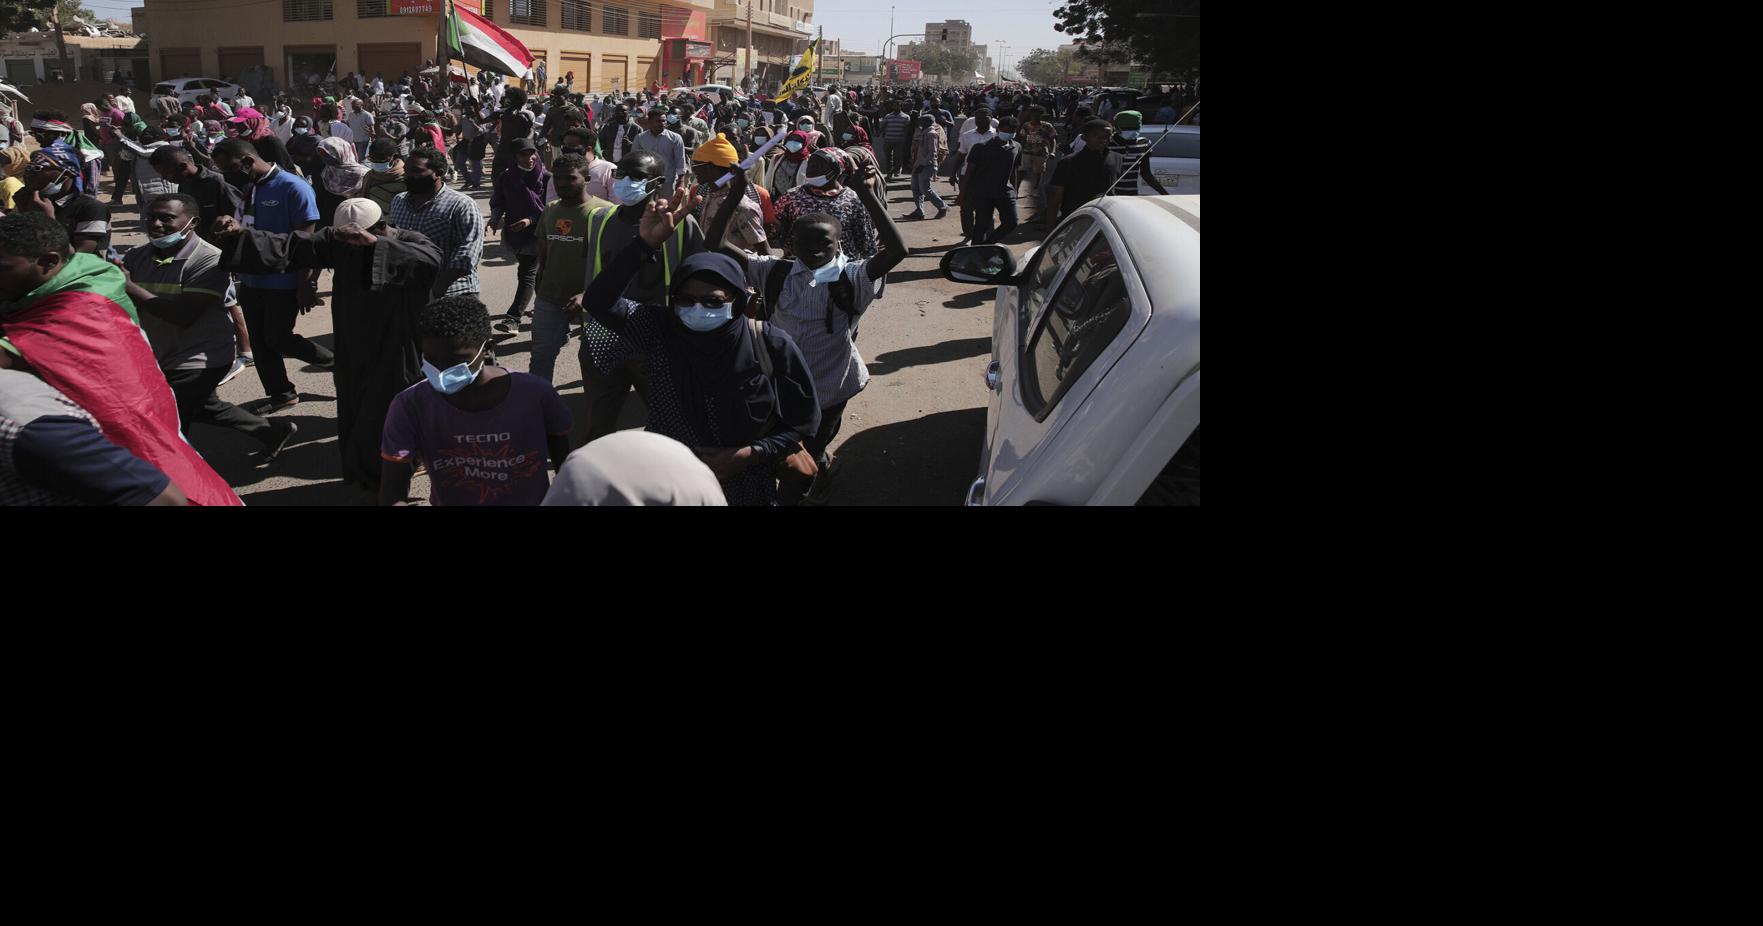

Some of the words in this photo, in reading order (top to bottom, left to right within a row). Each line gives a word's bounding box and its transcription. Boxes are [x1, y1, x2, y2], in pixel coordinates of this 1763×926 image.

[546, 234, 584, 243] ORSCHE
[453, 432, 511, 443] TECNO
[432, 454, 526, 471] Experience
[464, 466, 509, 480] More
